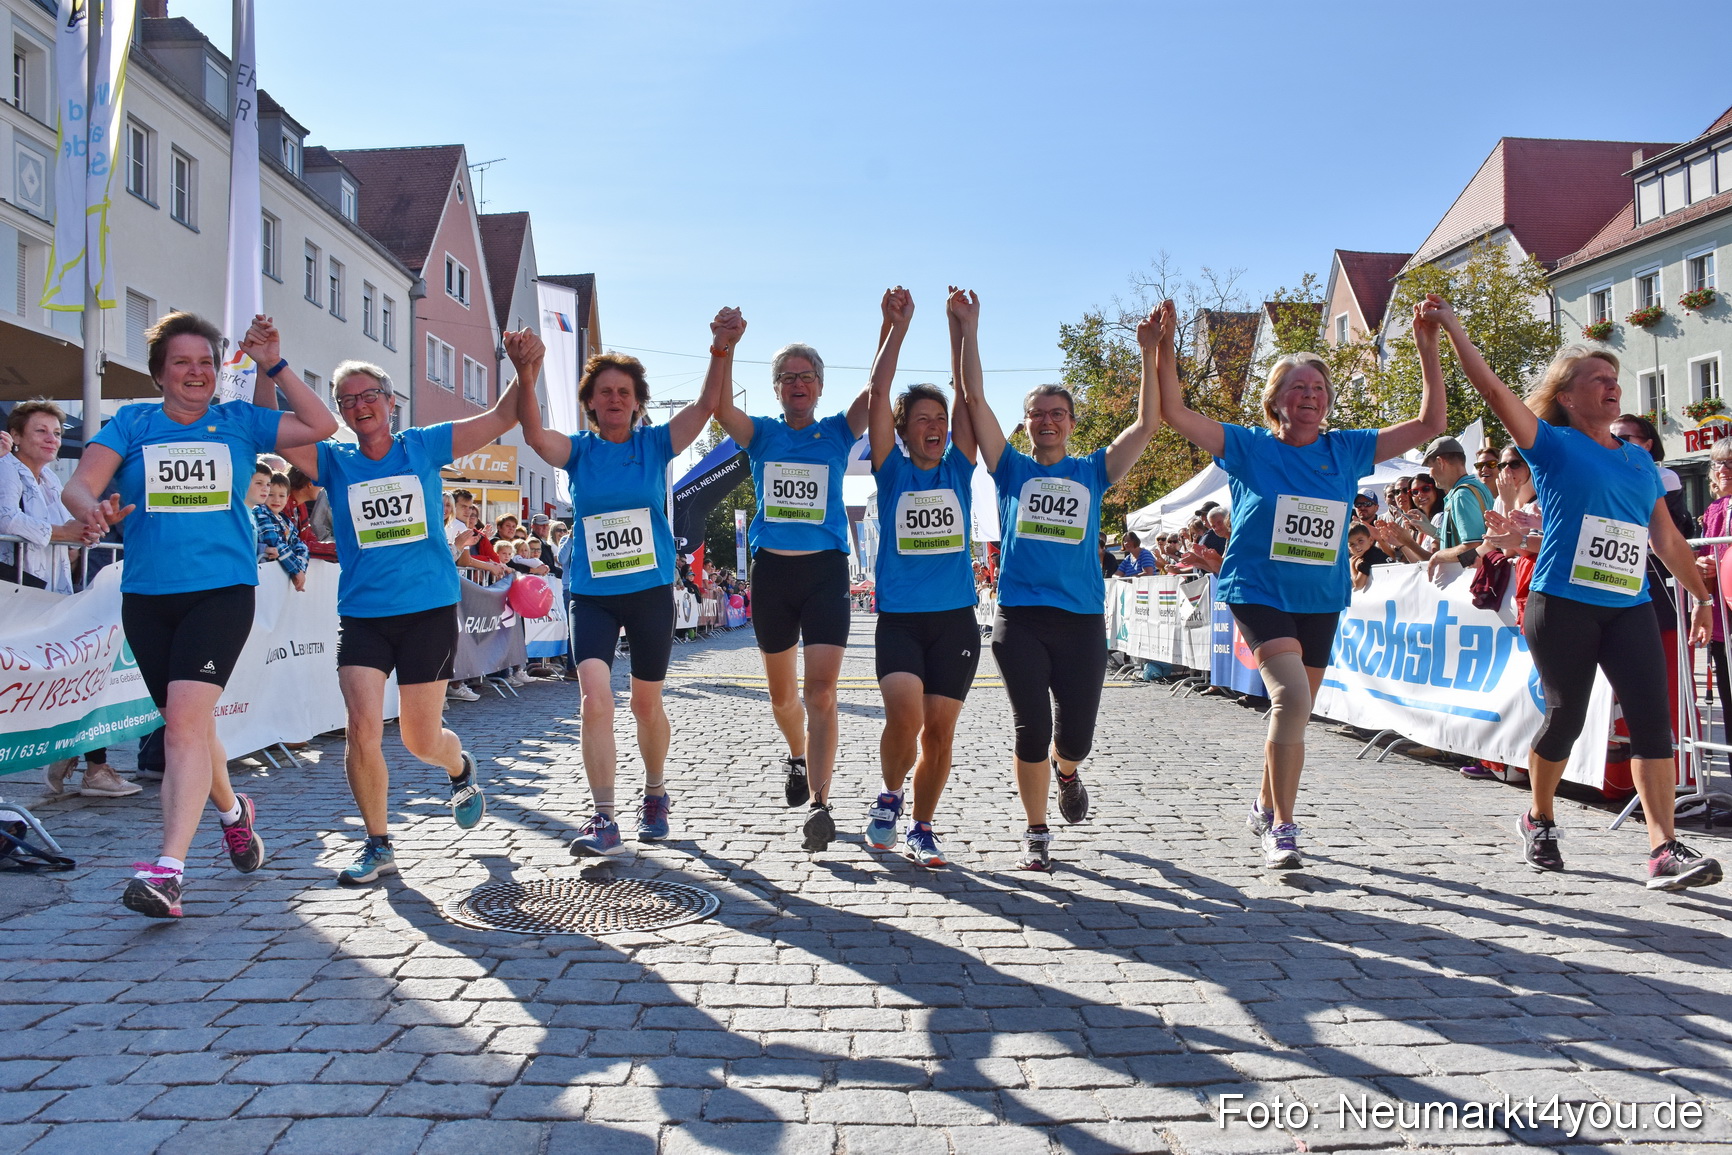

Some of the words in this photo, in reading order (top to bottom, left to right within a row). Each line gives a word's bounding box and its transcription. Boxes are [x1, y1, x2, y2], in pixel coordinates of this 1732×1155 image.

[1684, 424, 1732, 452] REN
[159, 460, 216, 482] 5041
[676, 484, 701, 501] PARTL
[700, 459, 741, 488] NEUMARKT
[773, 480, 818, 500] 5039
[172, 495, 208, 504] Christa
[362, 494, 413, 520] 5037
[1029, 494, 1079, 517] 5042
[778, 509, 810, 518] Angelika
[906, 507, 954, 529] 5036
[376, 528, 411, 539] Gerlinde
[1035, 524, 1065, 536] Monika
[1285, 514, 1335, 539] 5038
[596, 527, 643, 551] 5040
[914, 539, 950, 548] Christine
[1288, 546, 1325, 559] Marianne
[1589, 536, 1640, 566] 5035
[606, 557, 640, 570] Gertraud
[1593, 570, 1628, 586] Barbara
[213, 704, 228, 717] ELNE
[229, 702, 249, 715] ZÄHLT
[20, 743, 32, 758] 63
